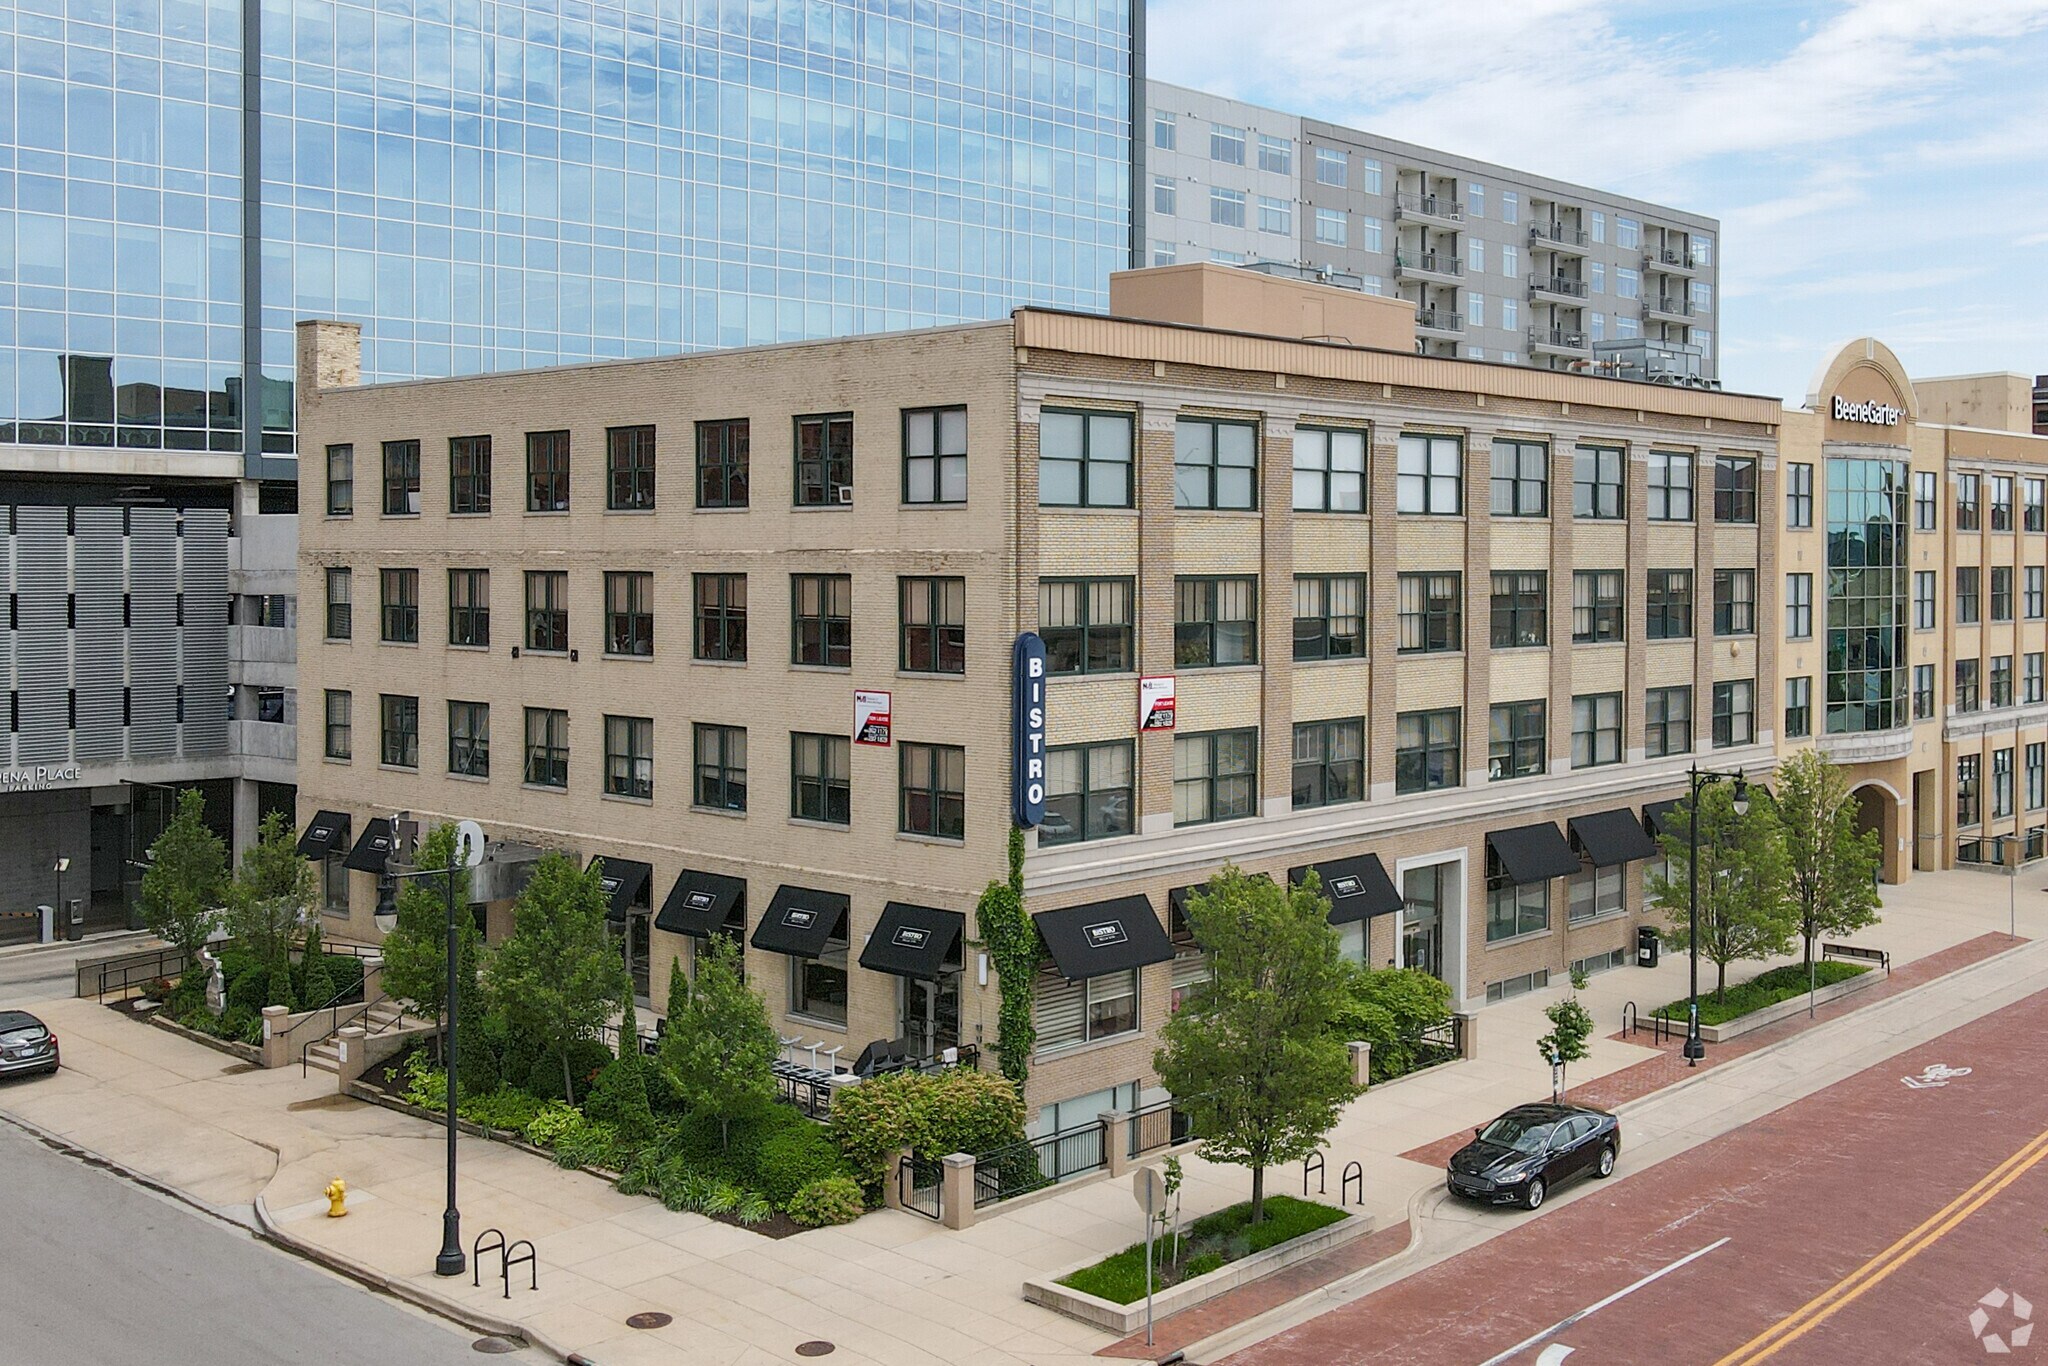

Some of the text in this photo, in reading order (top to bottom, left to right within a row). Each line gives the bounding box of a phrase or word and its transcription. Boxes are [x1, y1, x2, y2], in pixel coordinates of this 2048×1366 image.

[1834, 395, 1899, 426] BeeneGarter
[1028, 657, 1044, 805] BISTRO
[0, 766, 81, 784] ENA PLACE
